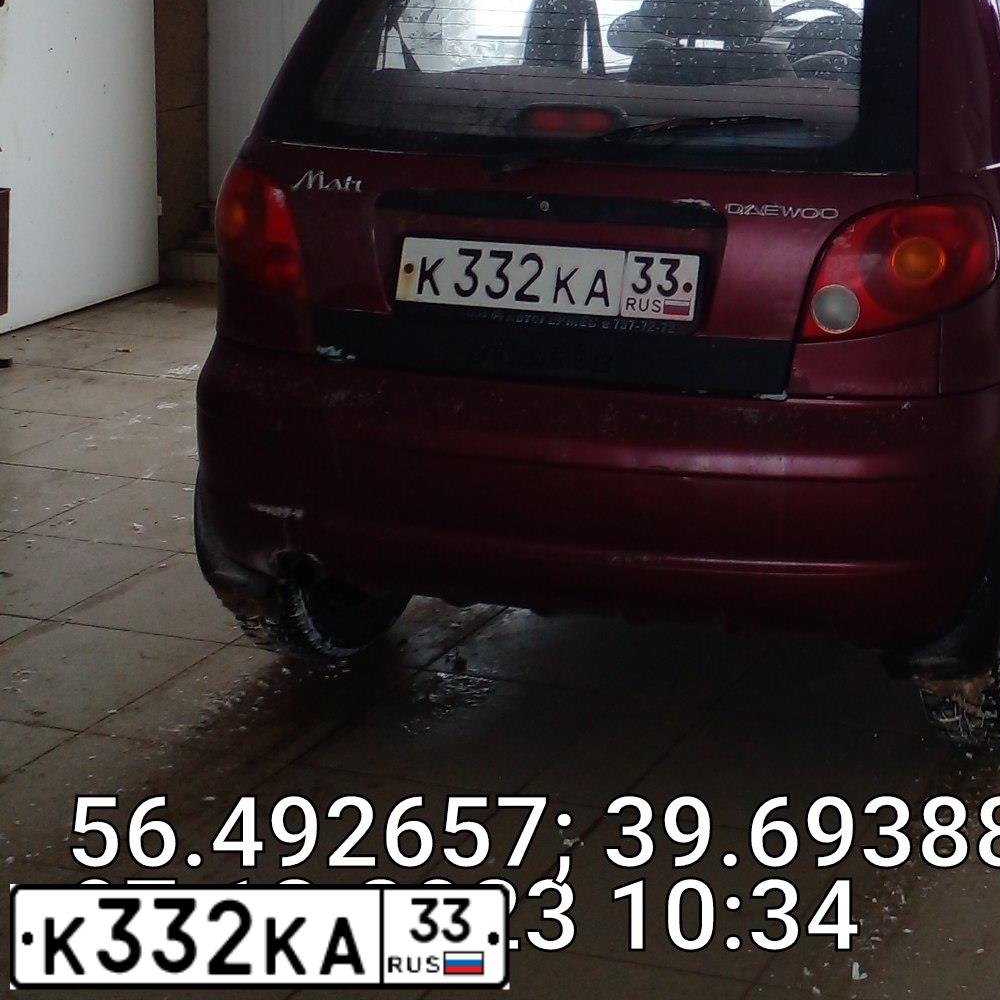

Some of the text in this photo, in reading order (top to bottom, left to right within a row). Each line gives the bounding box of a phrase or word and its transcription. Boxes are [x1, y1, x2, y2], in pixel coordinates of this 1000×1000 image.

[725, 203, 839, 219] DAEWOO
[631, 256, 681, 297] 33
[625, 298, 662, 313] RUS
